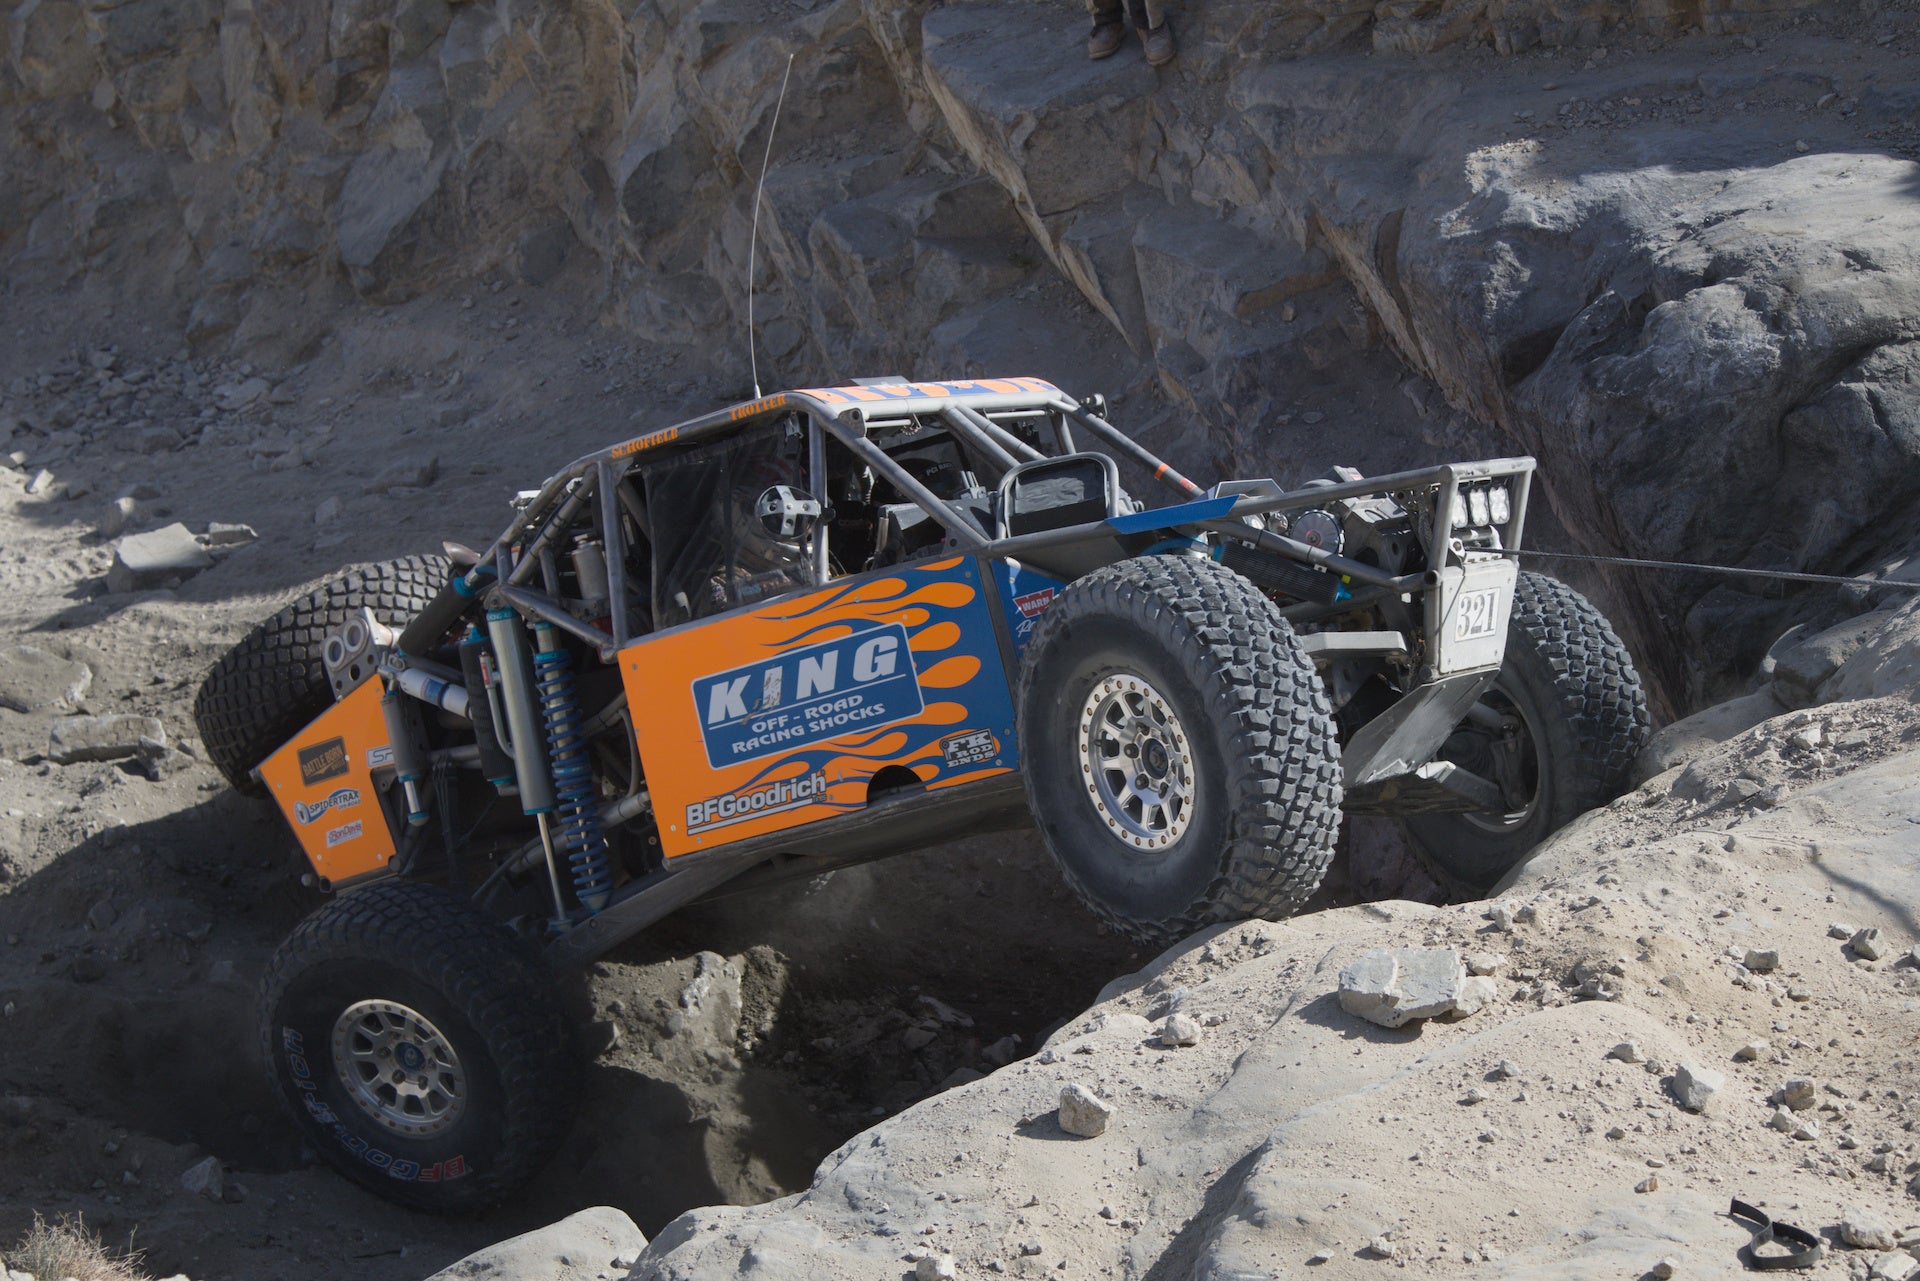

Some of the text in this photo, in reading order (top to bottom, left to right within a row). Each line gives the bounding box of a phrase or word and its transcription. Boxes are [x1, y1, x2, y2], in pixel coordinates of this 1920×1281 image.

[730, 393, 787, 421] TROTTER
[1021, 596, 1050, 612] WARN
[1457, 592, 1496, 638] 321
[707, 635, 899, 725] KING
[731, 703, 886, 754] RACING SHOCKS
[947, 731, 991, 753] FK
[955, 744, 993, 759] ROD
[946, 750, 995, 768] ENDS
[309, 789, 360, 814] SPIDERTRAX
[686, 773, 826, 828] BFGoodrich
